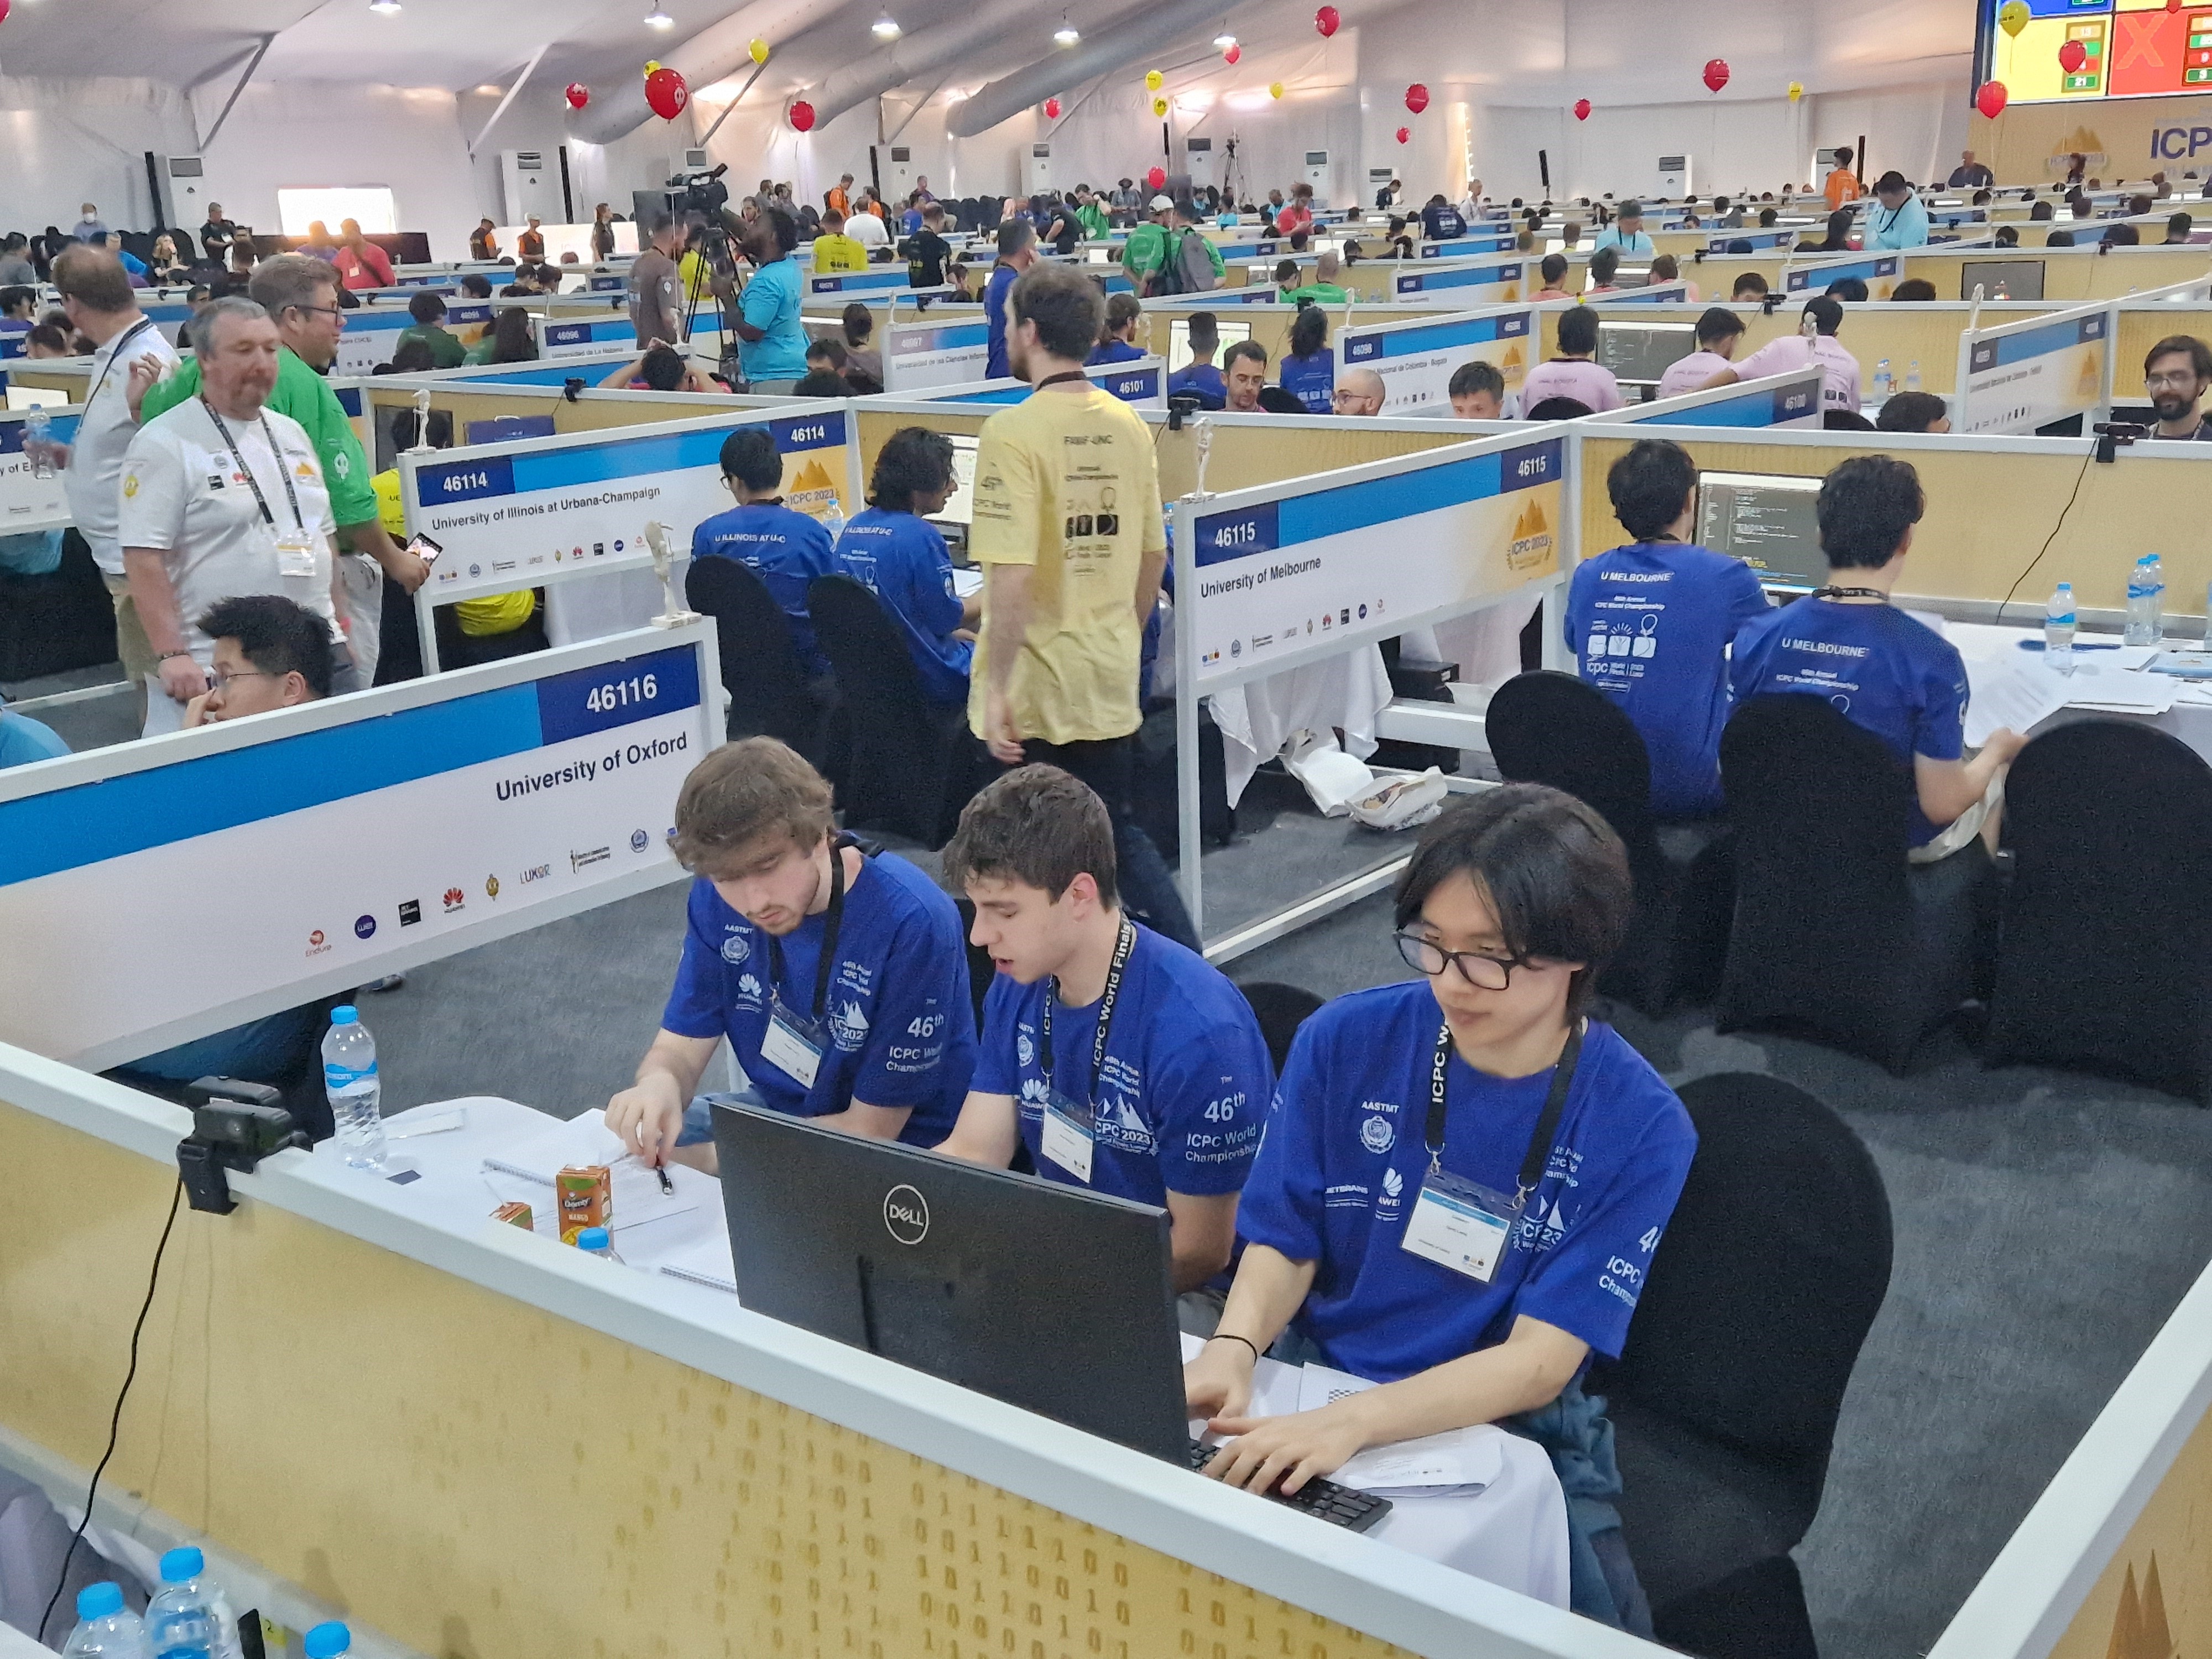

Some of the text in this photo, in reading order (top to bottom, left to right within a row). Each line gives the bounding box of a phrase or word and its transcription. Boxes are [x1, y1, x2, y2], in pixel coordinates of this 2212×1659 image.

[1119, 380, 1144, 394] 46101
[791, 425, 825, 442] 46114
[1518, 456, 1546, 477] 46115
[443, 471, 488, 492] 46114
[432, 487, 660, 530] University of Illinois at Urbana-Champaign
[1215, 521, 1256, 549] 46115
[1201, 556, 1322, 599] University of Melbourne
[1601, 572, 1609, 580] U
[1782, 638, 1791, 648] U
[587, 674, 658, 713] 46116
[496, 731, 687, 801] University of Oxford
[1092, 923, 1131, 1067] ICPC World Finals
[889, 1045, 921, 1060] ICPC
[1432, 1051, 1446, 1103] ICPC
[1204, 1091, 1246, 1123] 46th
[1361, 1100, 1400, 1114] AASTMT
[1095, 1120, 1151, 1145] CPC 2023
[1186, 1123, 1256, 1148] ICPC World
[889, 1204, 925, 1228] DELL
[1606, 1255, 1641, 1284] ICPC
